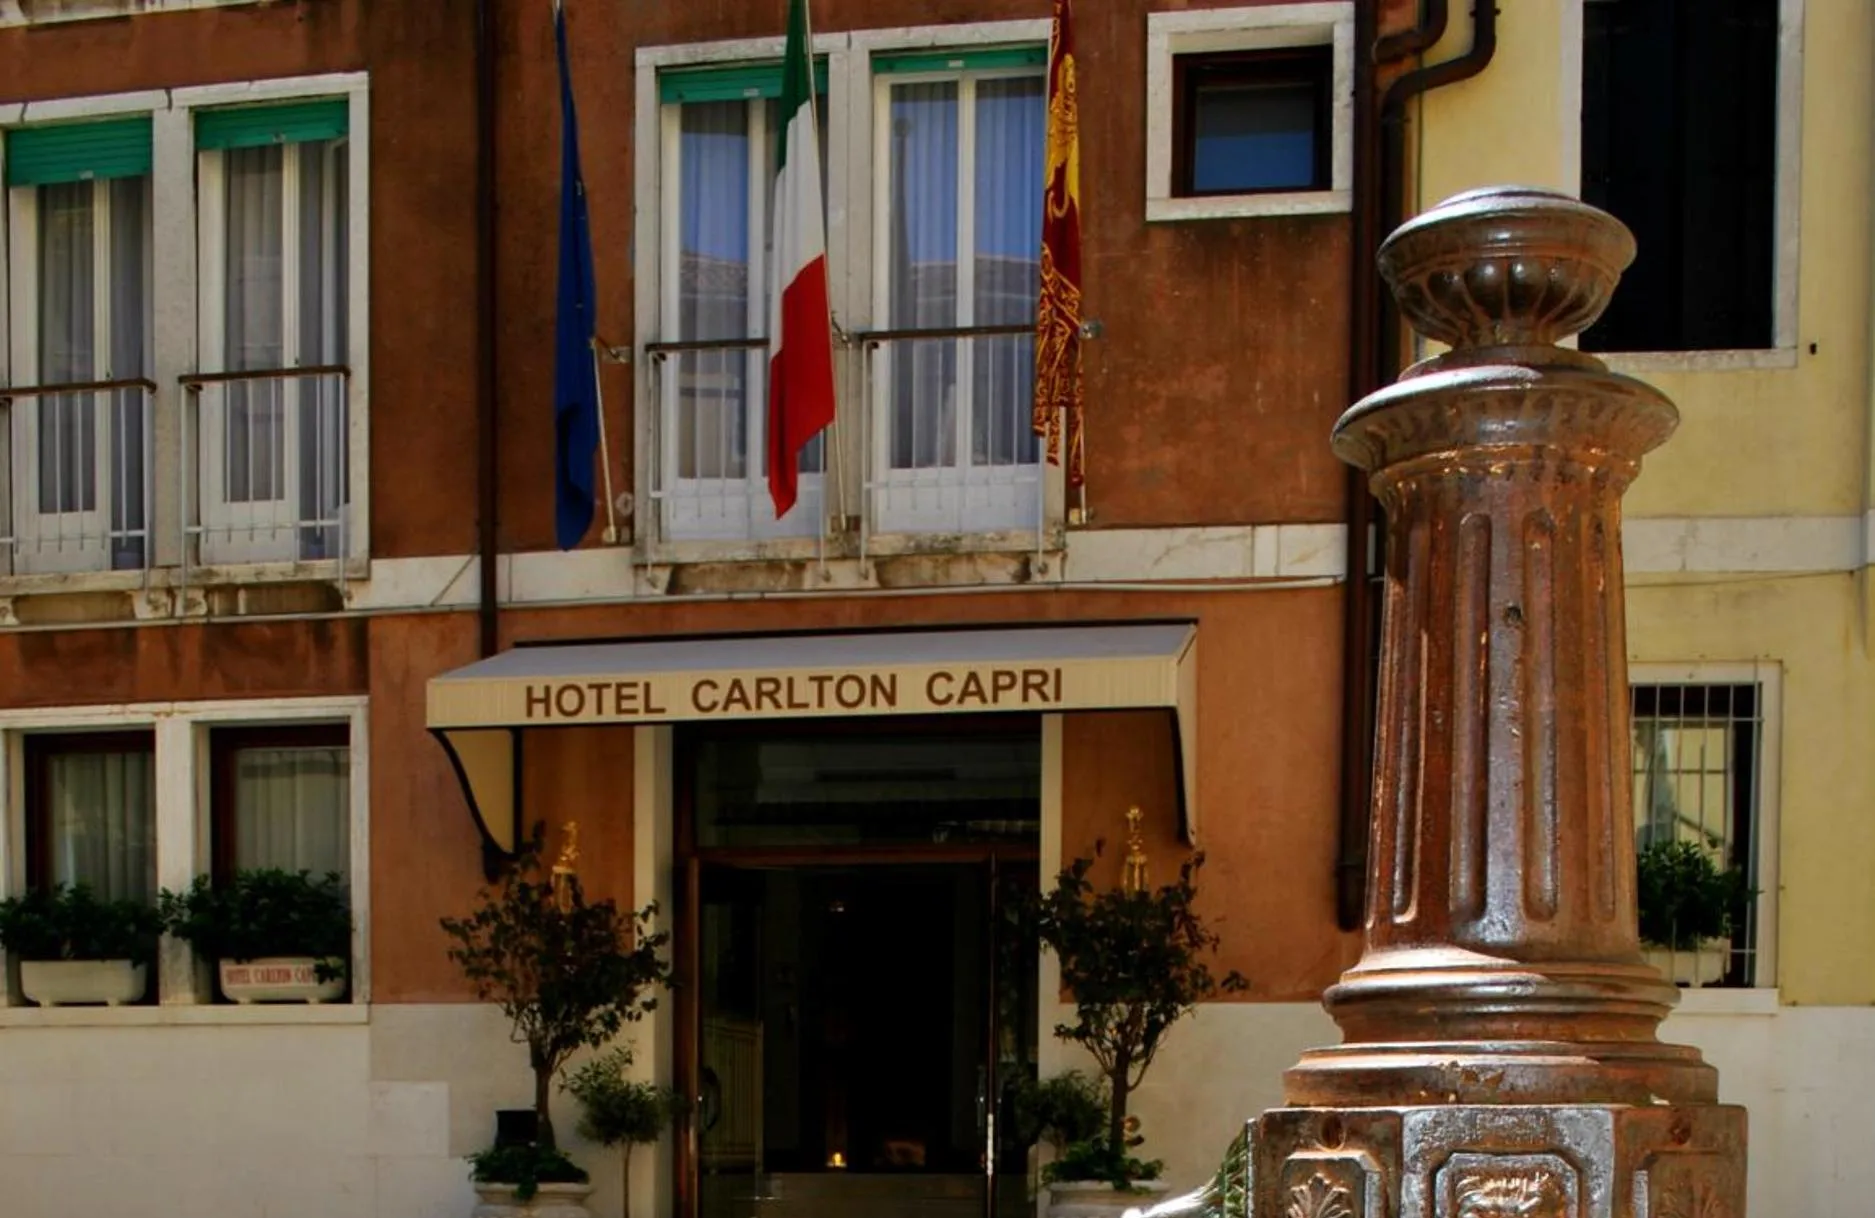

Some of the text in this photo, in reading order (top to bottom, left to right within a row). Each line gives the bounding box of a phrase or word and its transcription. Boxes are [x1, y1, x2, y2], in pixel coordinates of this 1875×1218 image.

[525, 667, 1063, 720] HOTEL CARLTON CAPRI
